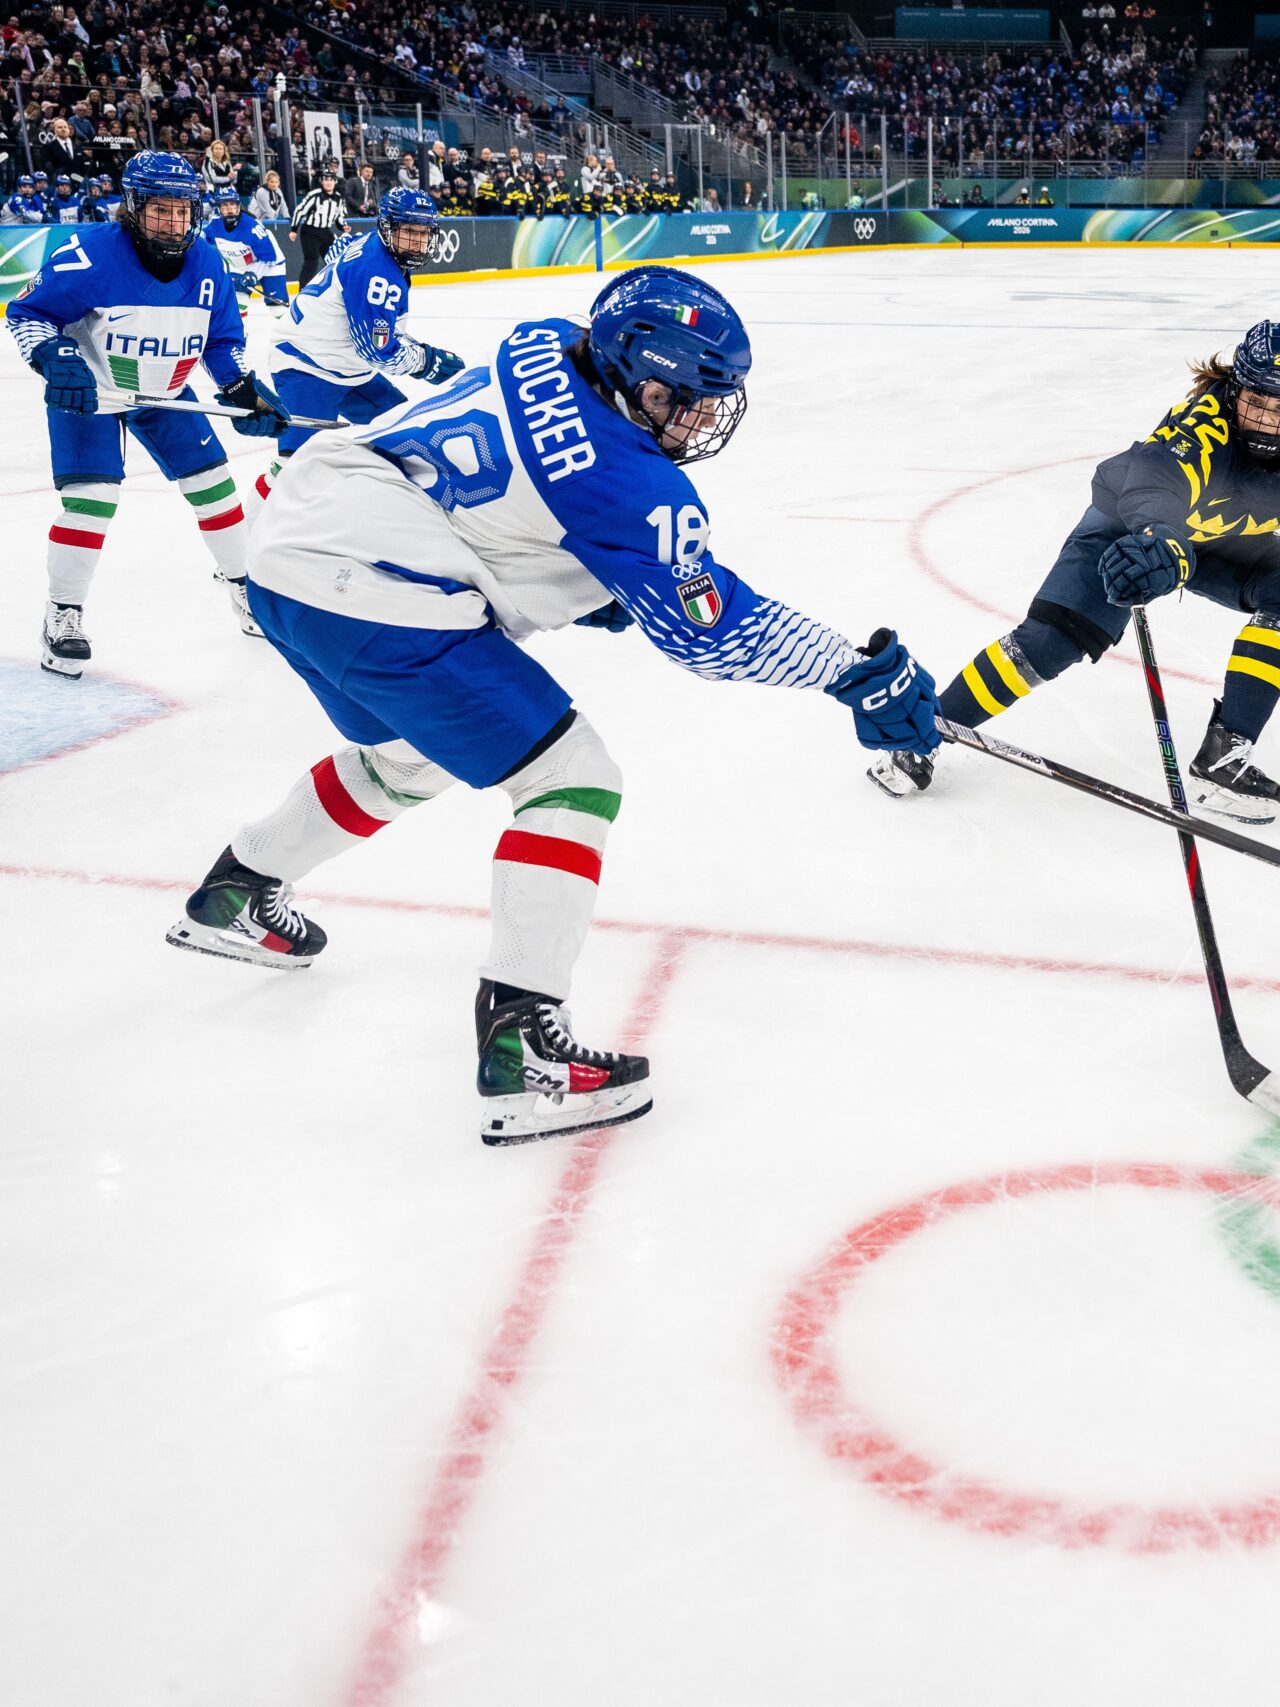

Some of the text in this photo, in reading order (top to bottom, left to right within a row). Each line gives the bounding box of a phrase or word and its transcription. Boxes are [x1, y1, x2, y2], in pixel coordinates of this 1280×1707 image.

[987, 218, 1058, 227] MILANO CORTINA
[50, 232, 93, 273] 77
[198, 278, 215, 306] A
[366, 275, 402, 311] 82
[105, 332, 204, 357] ITALIA
[425, 355, 443, 381] CM
[641, 349, 679, 371] CCM
[227, 381, 245, 394] CCM
[507, 328, 597, 483] STOCKER
[645, 504, 709, 566] 18
[1165, 538, 1190, 589] CC
[680, 577, 711, 597] ITALIA
[1021, 753, 1042, 764] PRO
